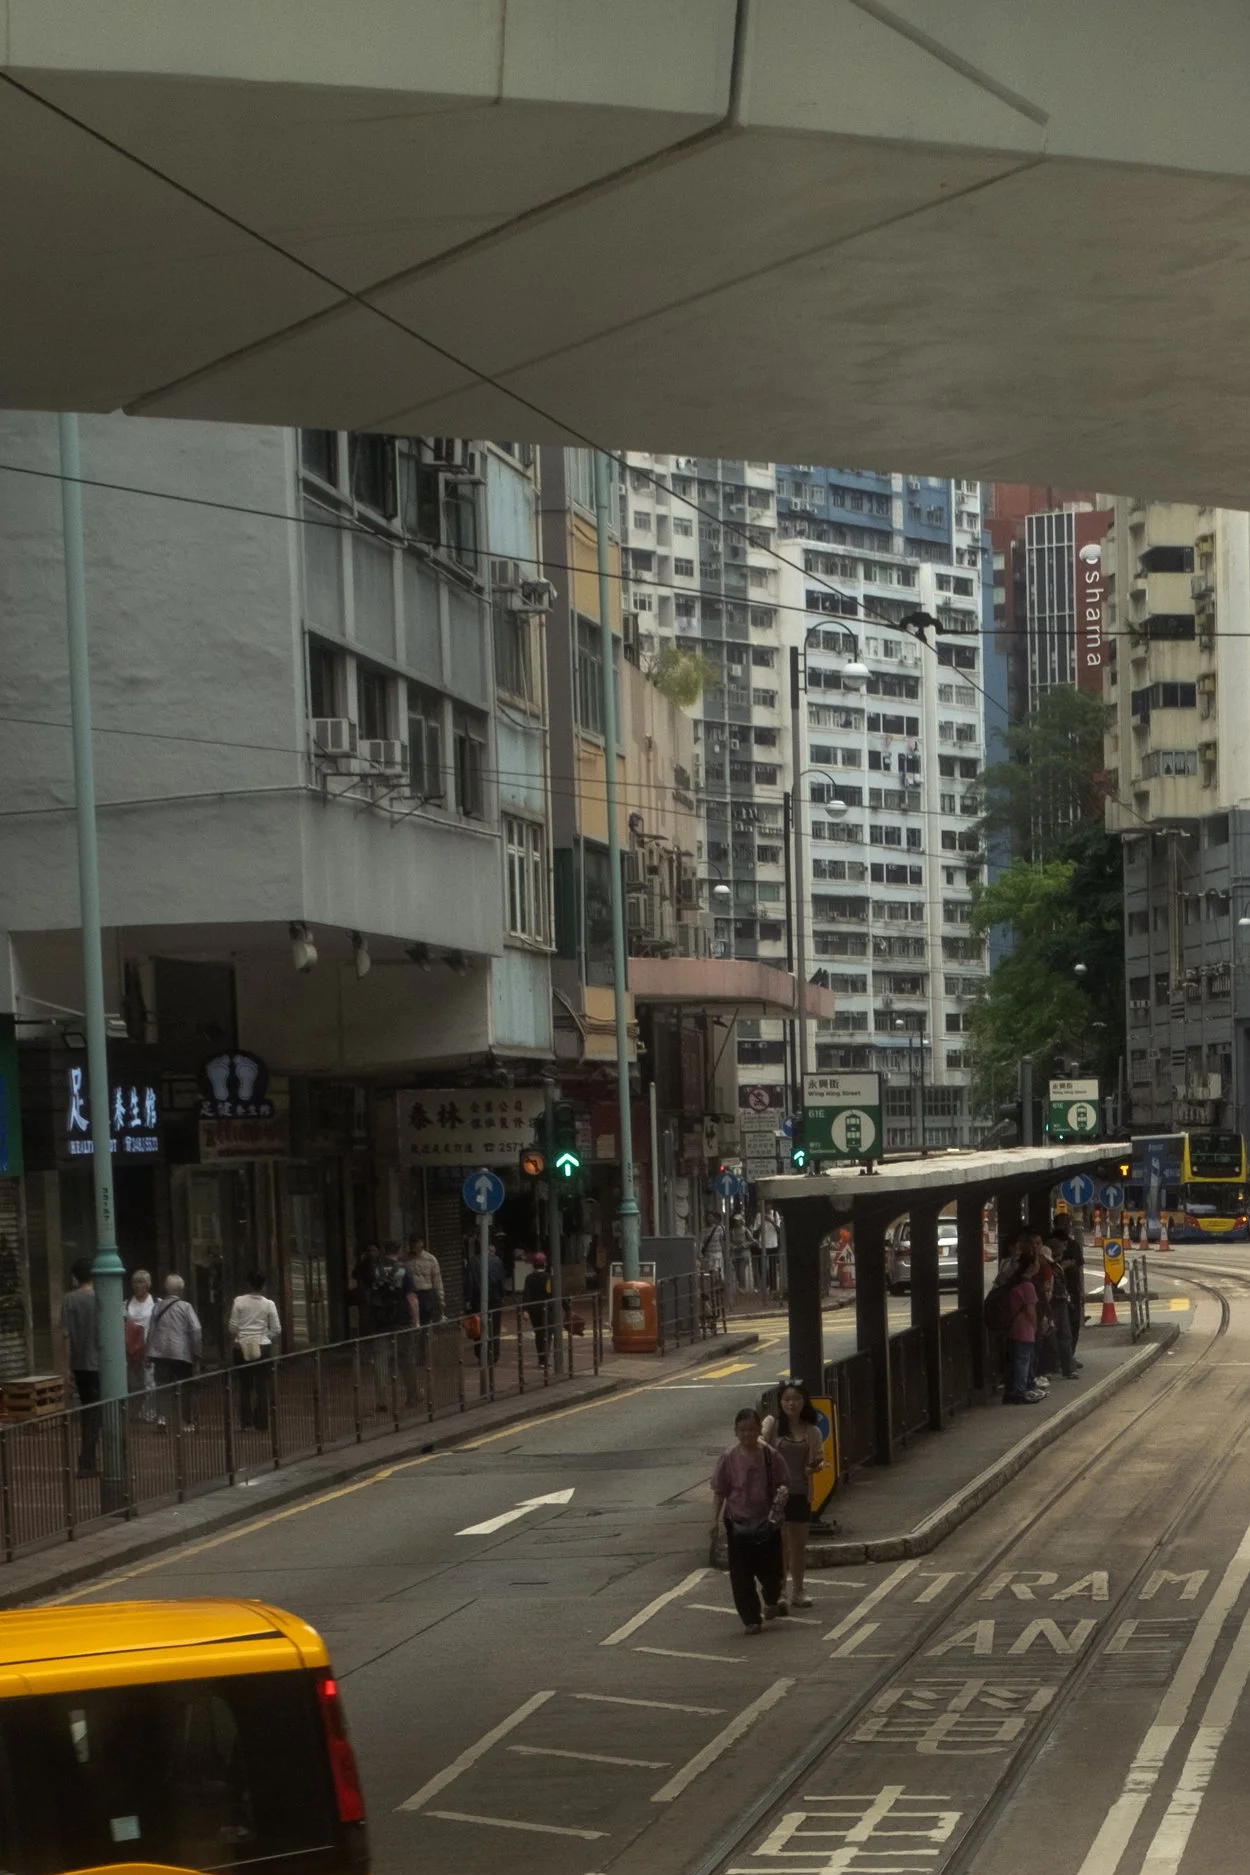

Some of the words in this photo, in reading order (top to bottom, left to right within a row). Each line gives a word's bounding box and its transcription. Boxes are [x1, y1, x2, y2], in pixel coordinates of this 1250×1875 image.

[1084, 571, 1104, 666] shama
[67, 1065, 159, 1132] 足養生館
[807, 1079, 840, 1090] 永興街
[808, 1109, 825, 1119] 61E
[912, 1569, 1212, 1603] TRAM
[829, 1617, 1199, 1659] LANE
